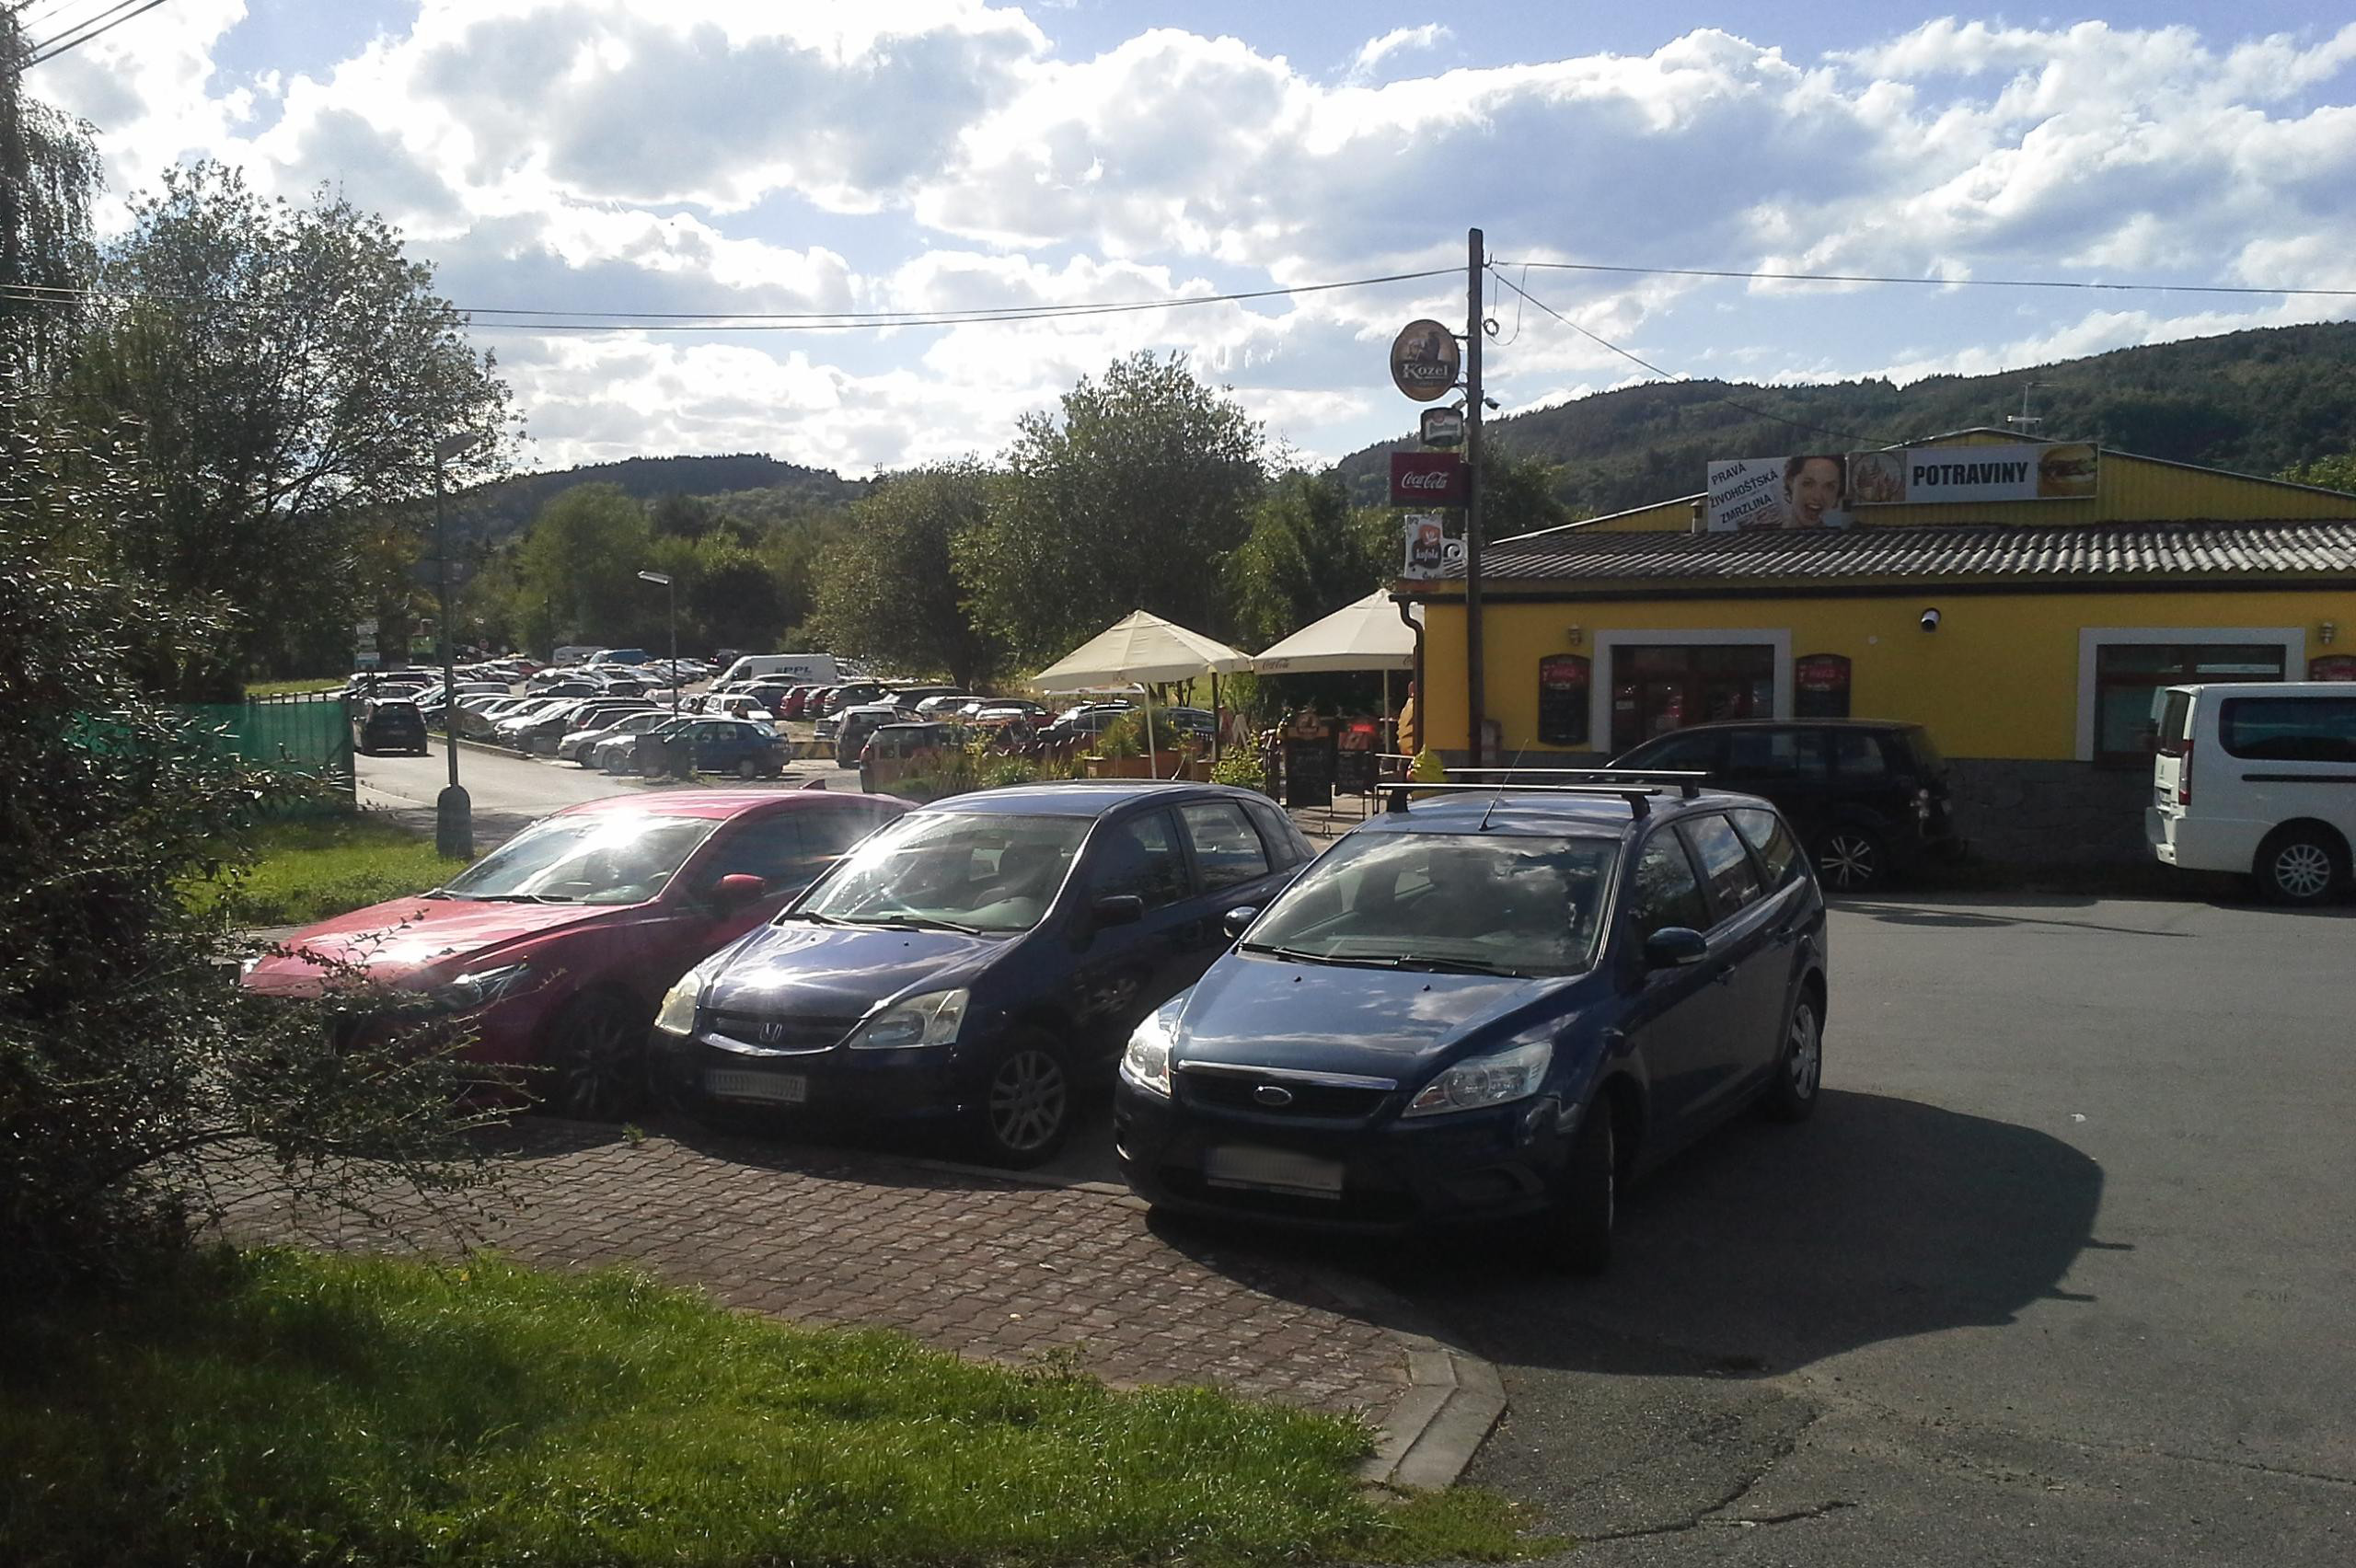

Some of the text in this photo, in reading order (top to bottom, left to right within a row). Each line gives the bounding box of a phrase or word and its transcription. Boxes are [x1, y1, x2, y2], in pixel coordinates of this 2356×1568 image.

[1403, 363, 1448, 379] Kozel
[1912, 461, 2028, 487] POTRAVINY
[1719, 493, 1773, 525] ZMRZLINA
